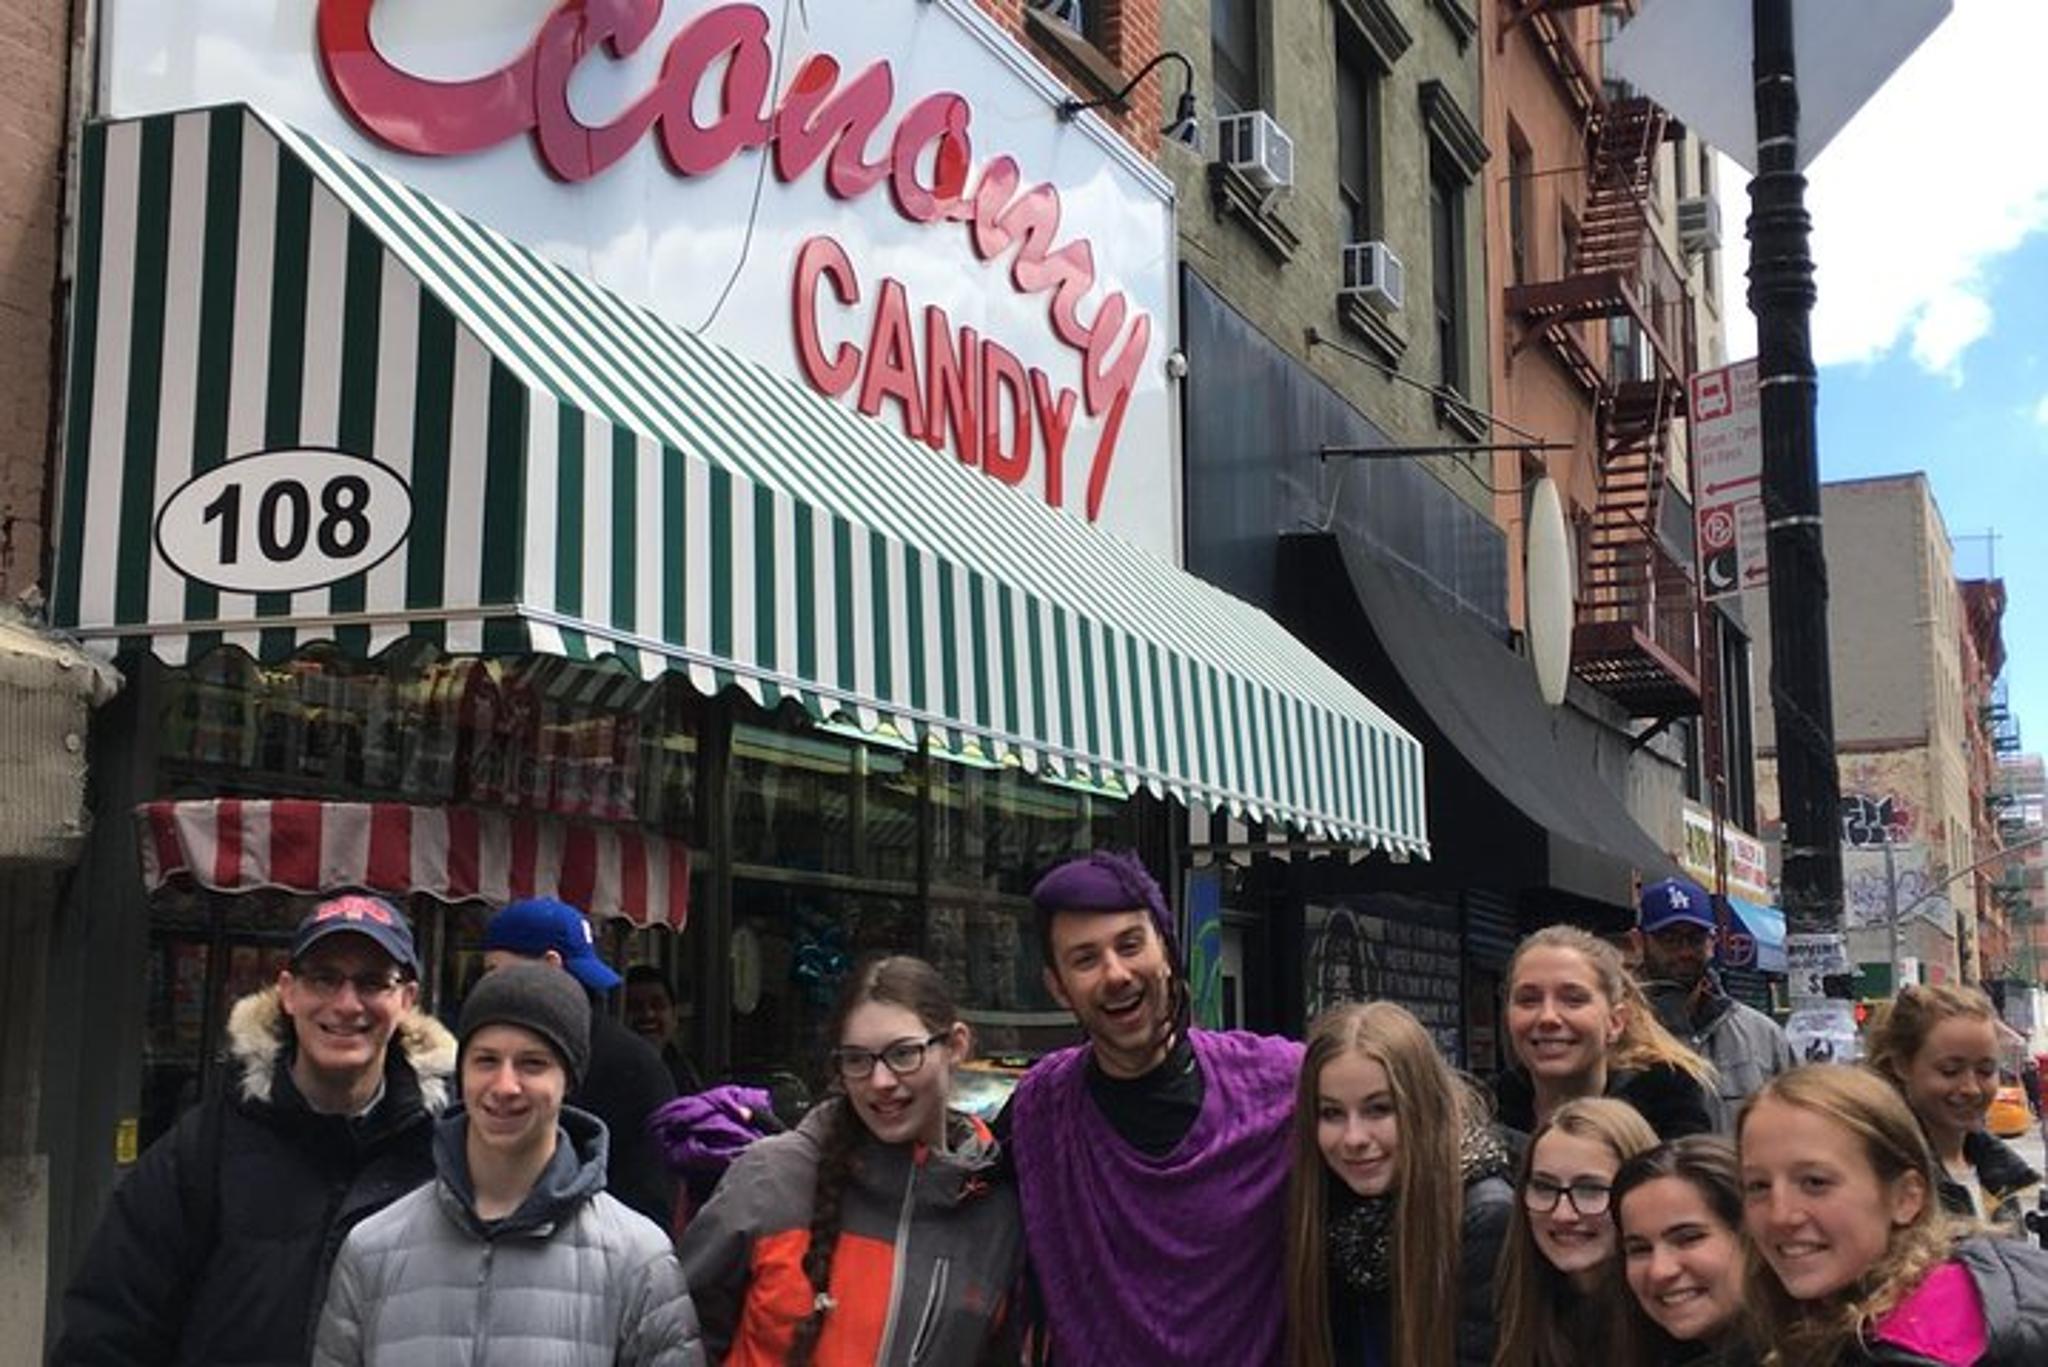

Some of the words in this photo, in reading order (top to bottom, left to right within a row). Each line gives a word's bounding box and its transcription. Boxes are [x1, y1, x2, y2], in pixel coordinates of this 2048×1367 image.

[792, 235, 1077, 508] CANDY
[203, 475, 371, 565] 108
[1667, 885, 1691, 909] LA
